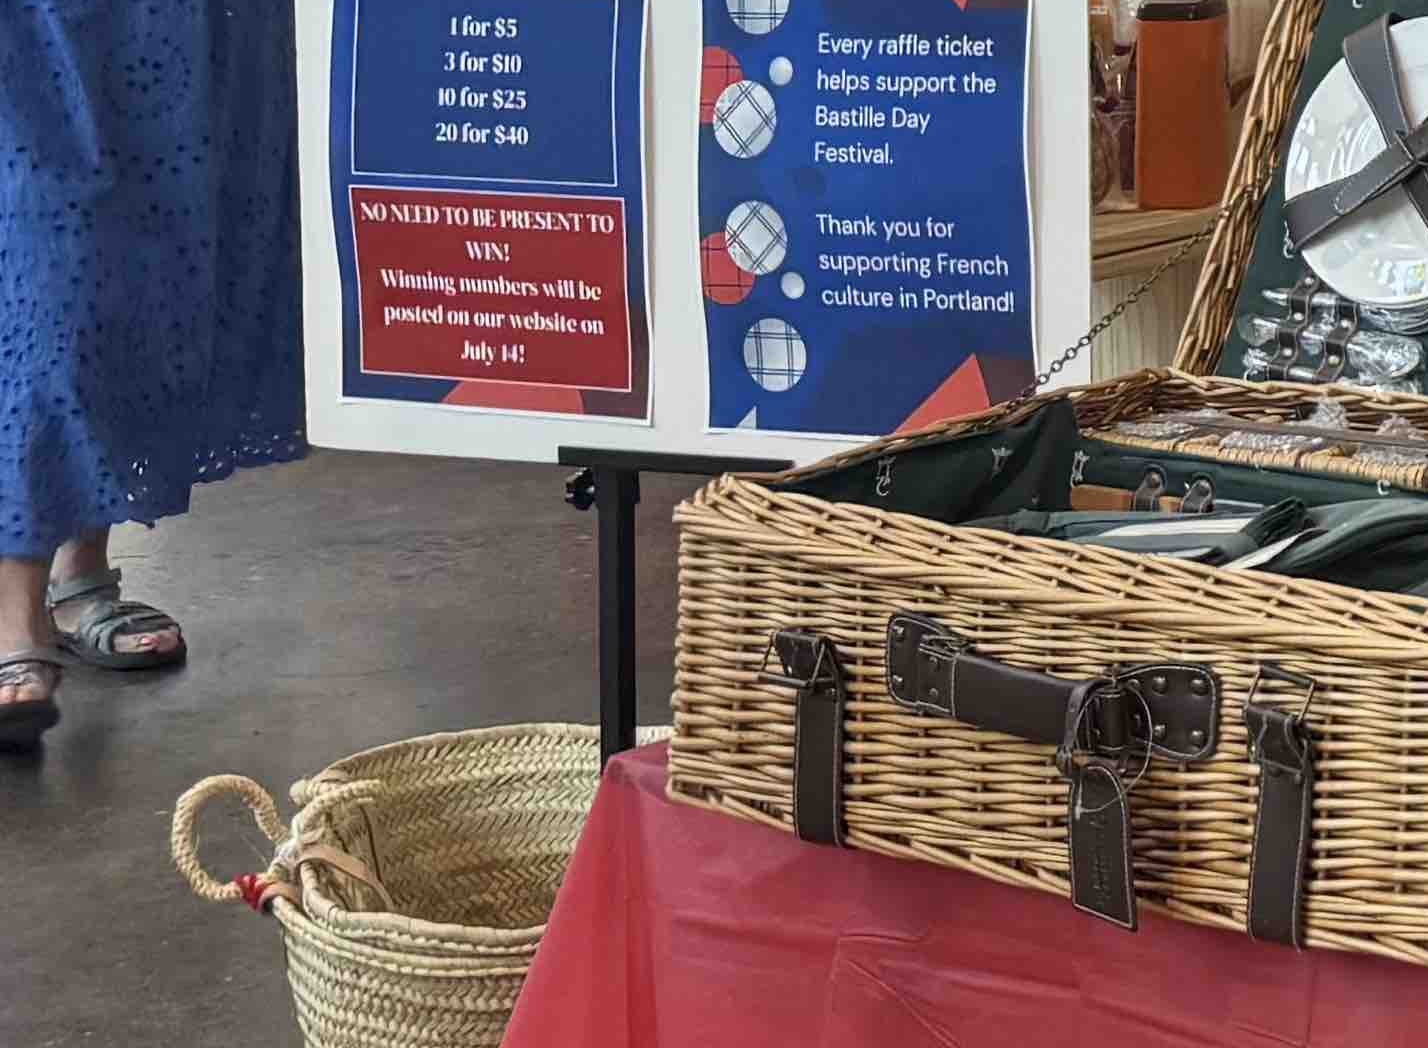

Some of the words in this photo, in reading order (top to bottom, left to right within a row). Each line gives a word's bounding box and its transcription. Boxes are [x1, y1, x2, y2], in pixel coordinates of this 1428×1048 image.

[450, 17, 458, 36] 1
[461, 15, 491, 37] for
[494, 17, 518, 39] $5
[818, 32, 873, 61] Every
[878, 32, 930, 56] raffle
[936, 34, 994, 57] ticket
[444, 52, 455, 72] 3
[459, 51, 489, 73] for
[492, 54, 522, 74] $10
[816, 69, 870, 96] helps
[876, 72, 956, 99] support
[962, 72, 996, 94] the
[438, 88, 456, 107] 10
[459, 86, 489, 109] for
[492, 89, 527, 110] $25
[815, 104, 885, 128] Bastille
[891, 107, 930, 134] Day
[435, 122, 458, 143] 20
[461, 121, 491, 144] for
[494, 124, 529, 145] $40
[814, 142, 894, 164] Festival.
[360, 202, 387, 222] NO
[390, 204, 440, 224] NEED
[441, 206, 469, 227] TO
[472, 207, 497, 228] BE
[500, 209, 583, 232] PRESENT
[587, 213, 615, 234] TO
[816, 214, 877, 237] Thank
[882, 220, 921, 242] you
[926, 216, 955, 238] for
[464, 240, 511, 263] WIN!
[818, 253, 931, 279] supporting
[937, 252, 1010, 277] French
[380, 268, 456, 296] Winning
[459, 275, 538, 297] numbers
[542, 278, 575, 299] will
[578, 280, 602, 301] be
[821, 285, 894, 308] culture
[900, 287, 918, 309] in
[923, 288, 1015, 313] Portland!
[384, 305, 443, 326] posted
[447, 309, 469, 326] on
[473, 310, 505, 328] our
[508, 310, 577, 333] website
[581, 318, 604, 335] on
[460, 340, 496, 366] July
[500, 343, 525, 363] 14!
